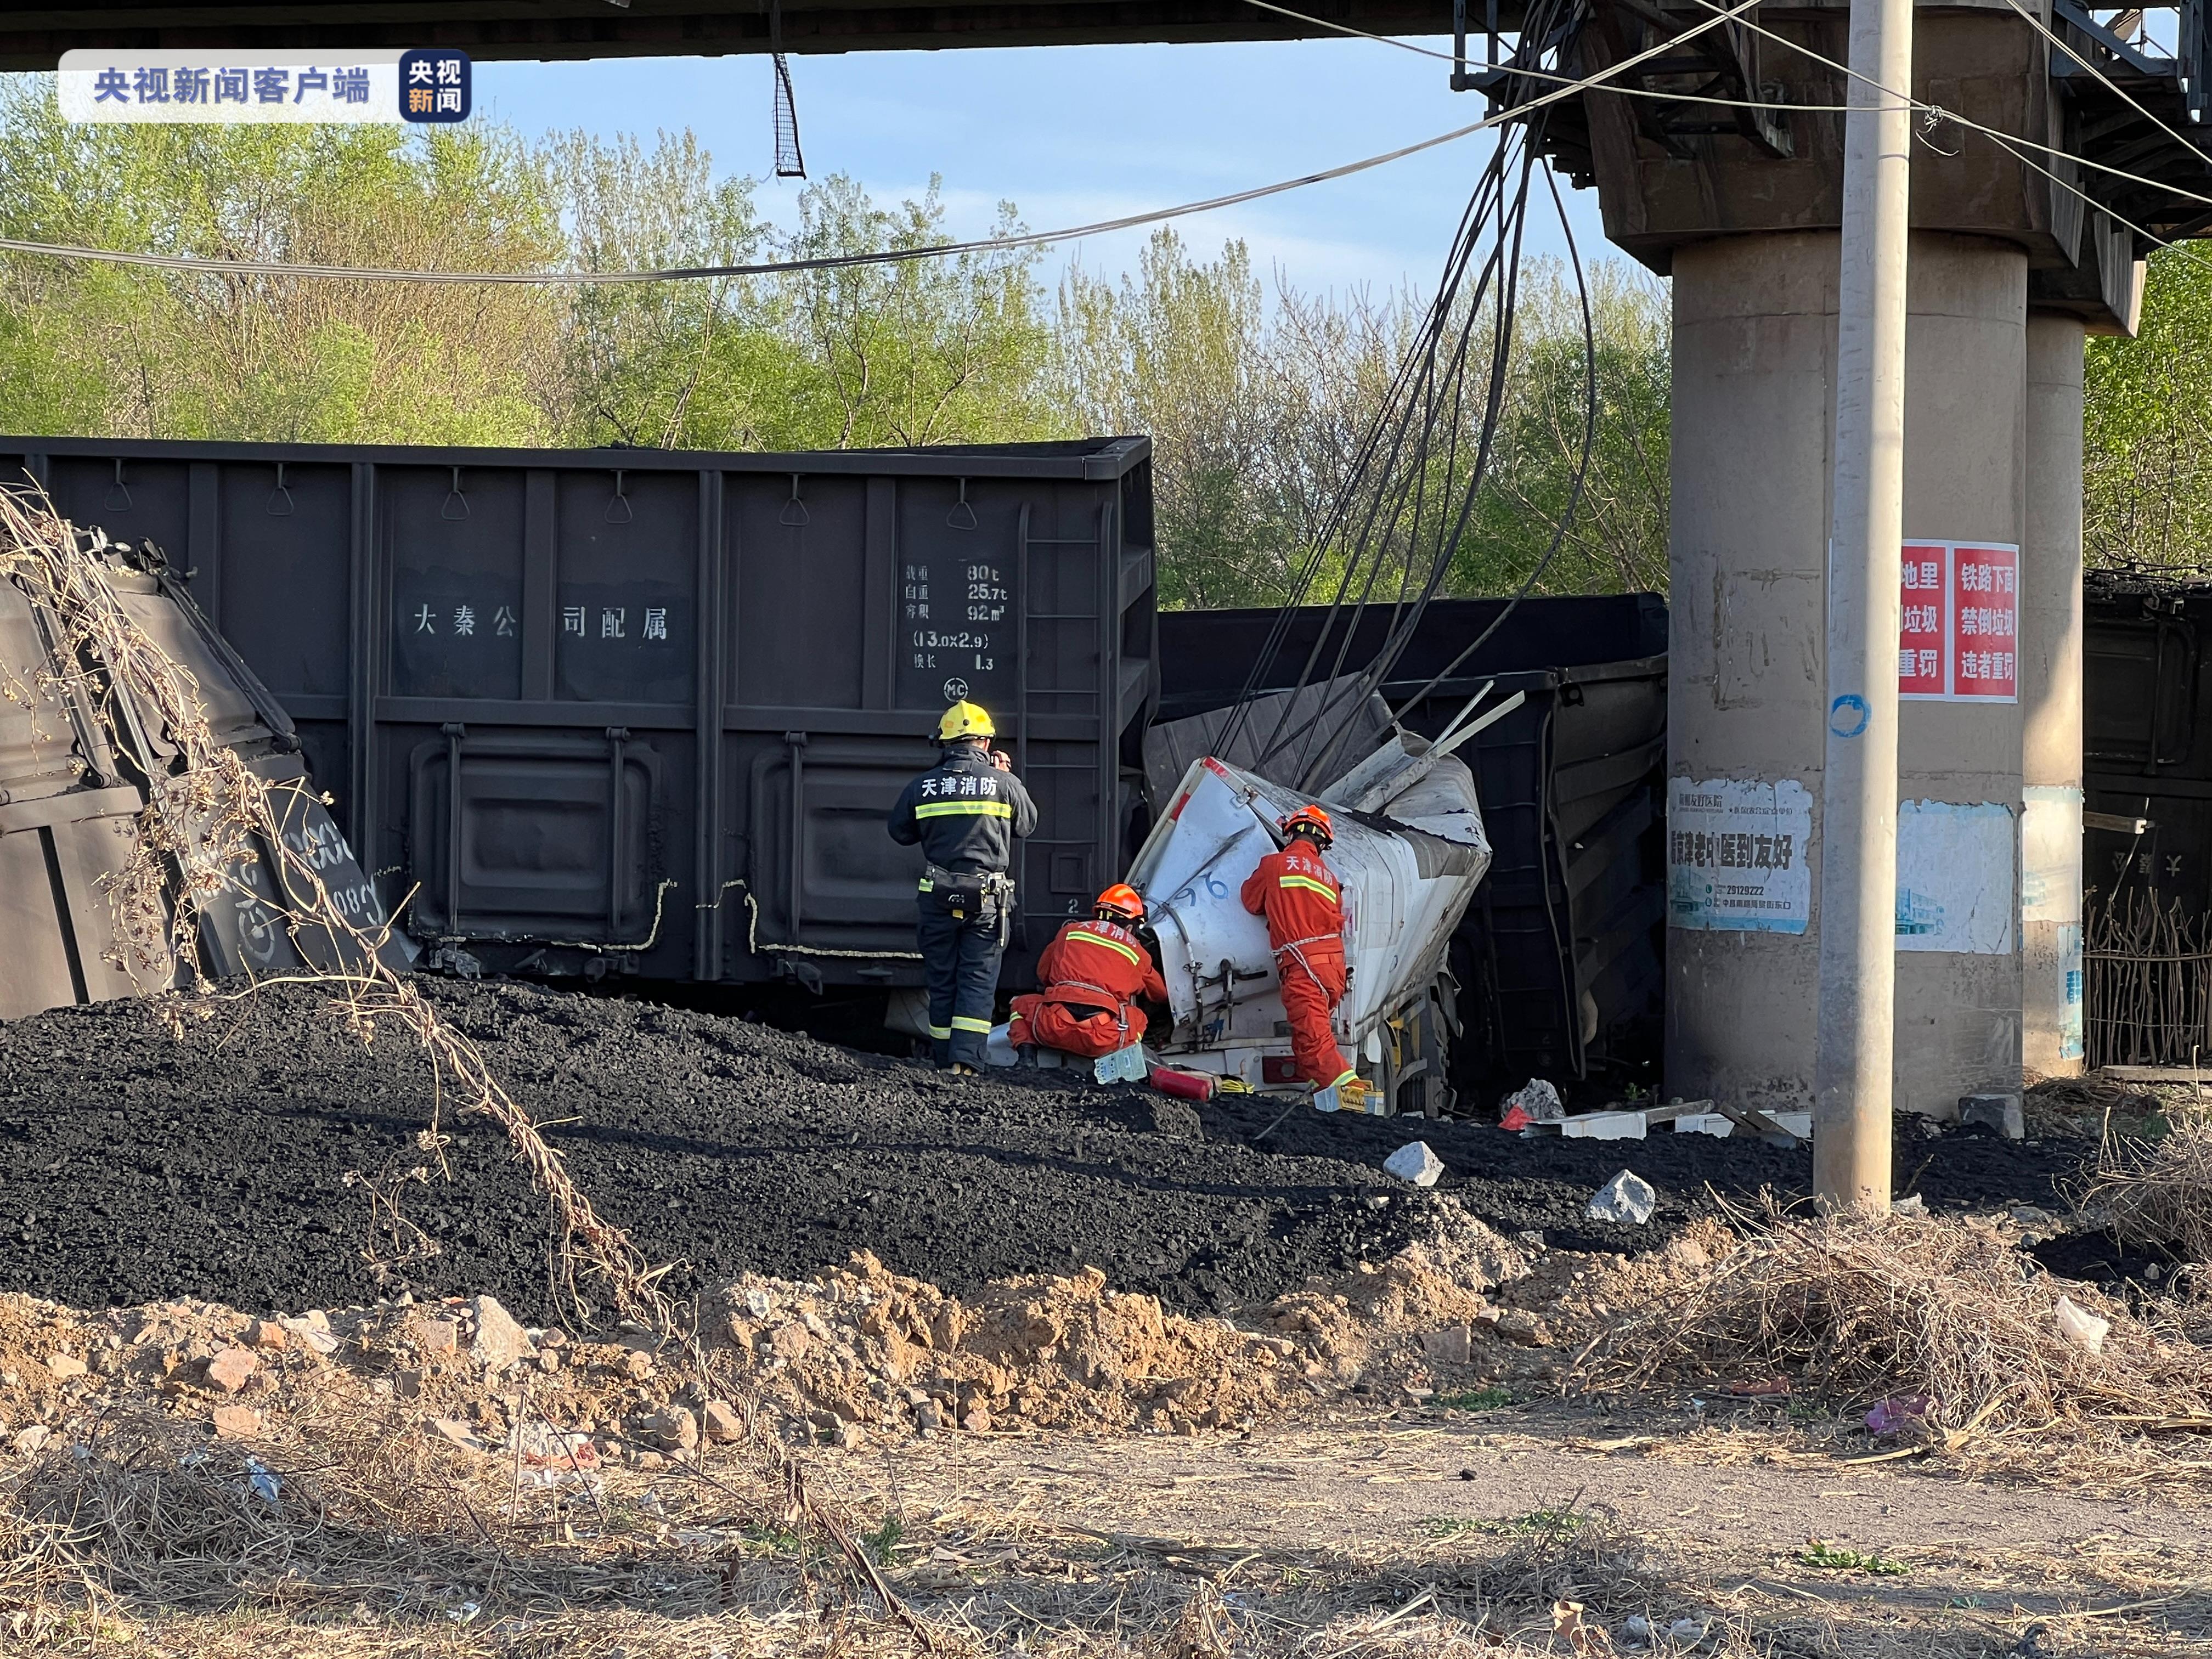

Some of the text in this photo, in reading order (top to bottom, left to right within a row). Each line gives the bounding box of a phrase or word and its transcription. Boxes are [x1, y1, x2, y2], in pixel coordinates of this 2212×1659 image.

[1961, 563, 2014, 594] 铁路下面
[905, 584, 1008, 600] 自重 25.7t
[1900, 605, 1938, 633] 垃圾
[1961, 606, 2014, 636] 禁倒垃圾
[1961, 651, 2014, 681] 违者重罚
[946, 684, 964, 696] MC
[922, 776, 998, 797] 天津消防
[1285, 855, 1333, 886] 天津消防
[1726, 885, 1764, 896] 29129222
[1068, 898, 1079, 913] 2
